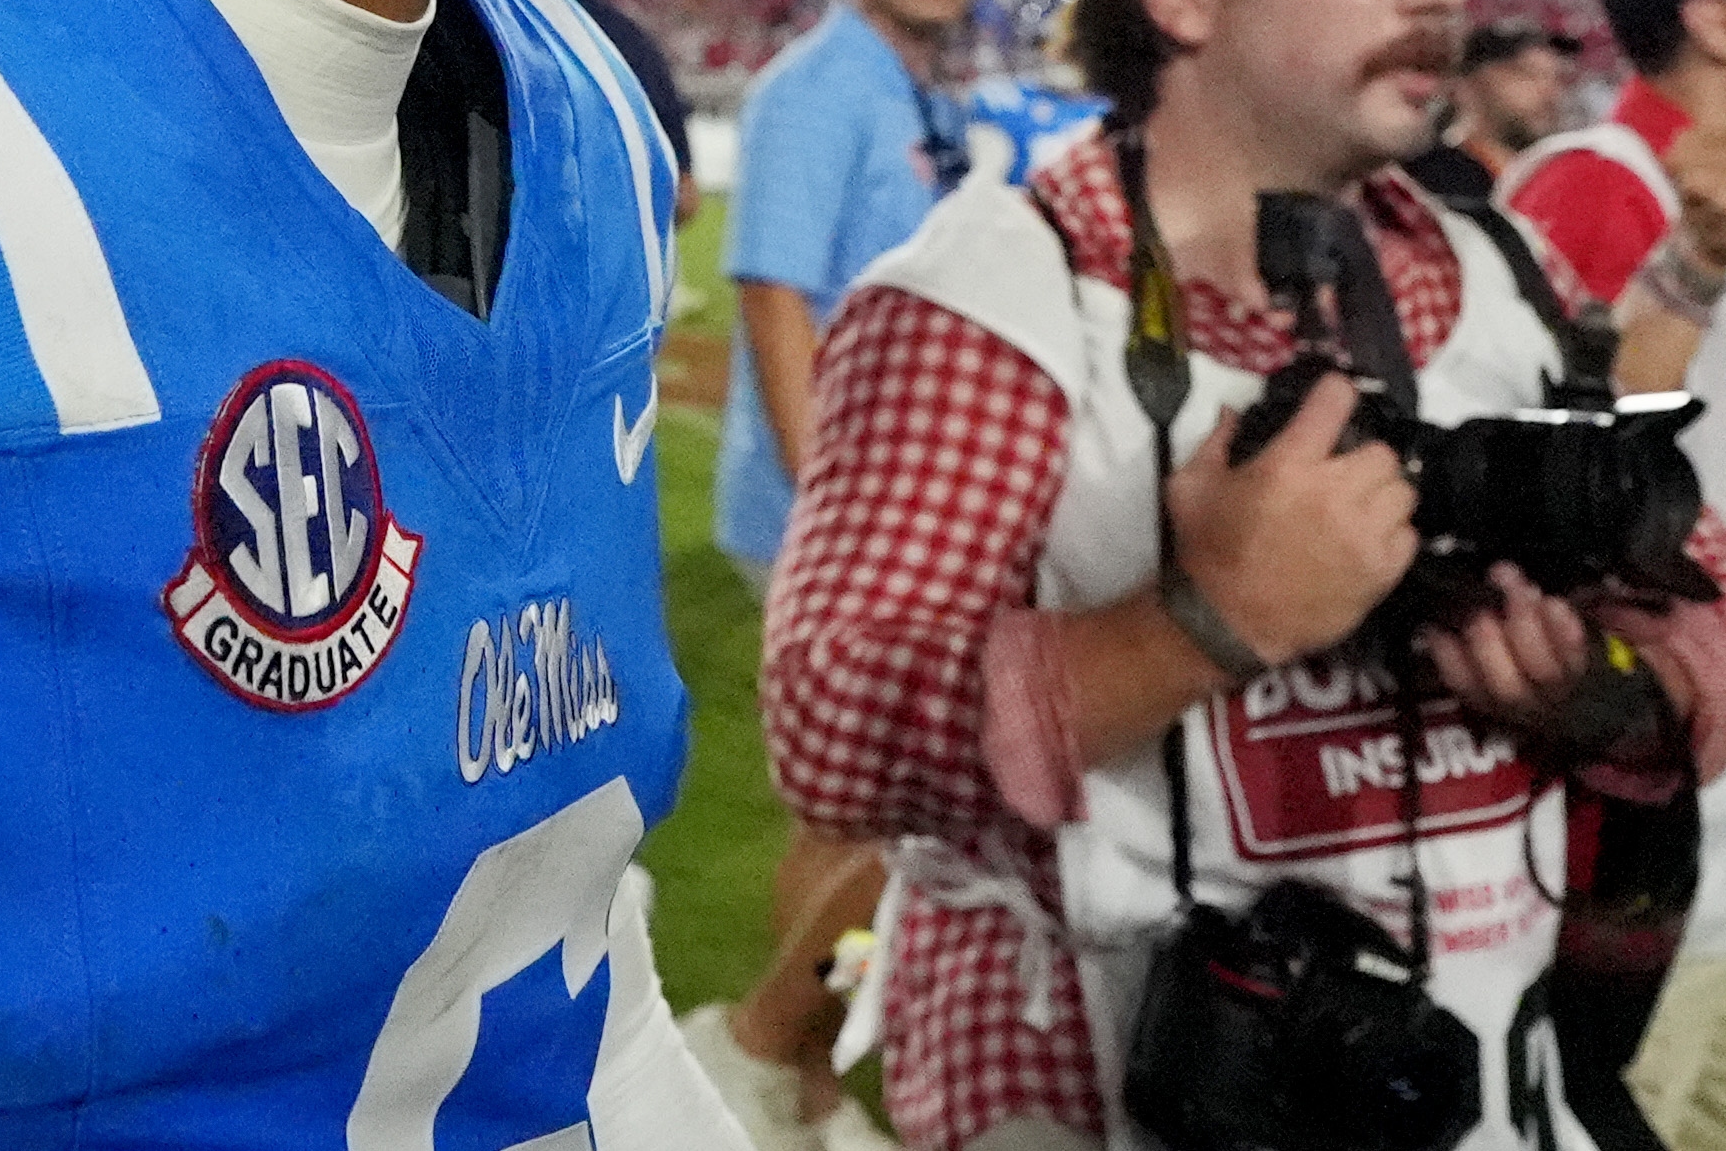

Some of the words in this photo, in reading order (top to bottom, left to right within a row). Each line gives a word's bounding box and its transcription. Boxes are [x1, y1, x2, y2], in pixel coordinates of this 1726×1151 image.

[219, 382, 370, 618] SEC
[203, 584, 398, 700] GRADUATE
[458, 615, 537, 784] Ole
[519, 598, 619, 754] Miss
